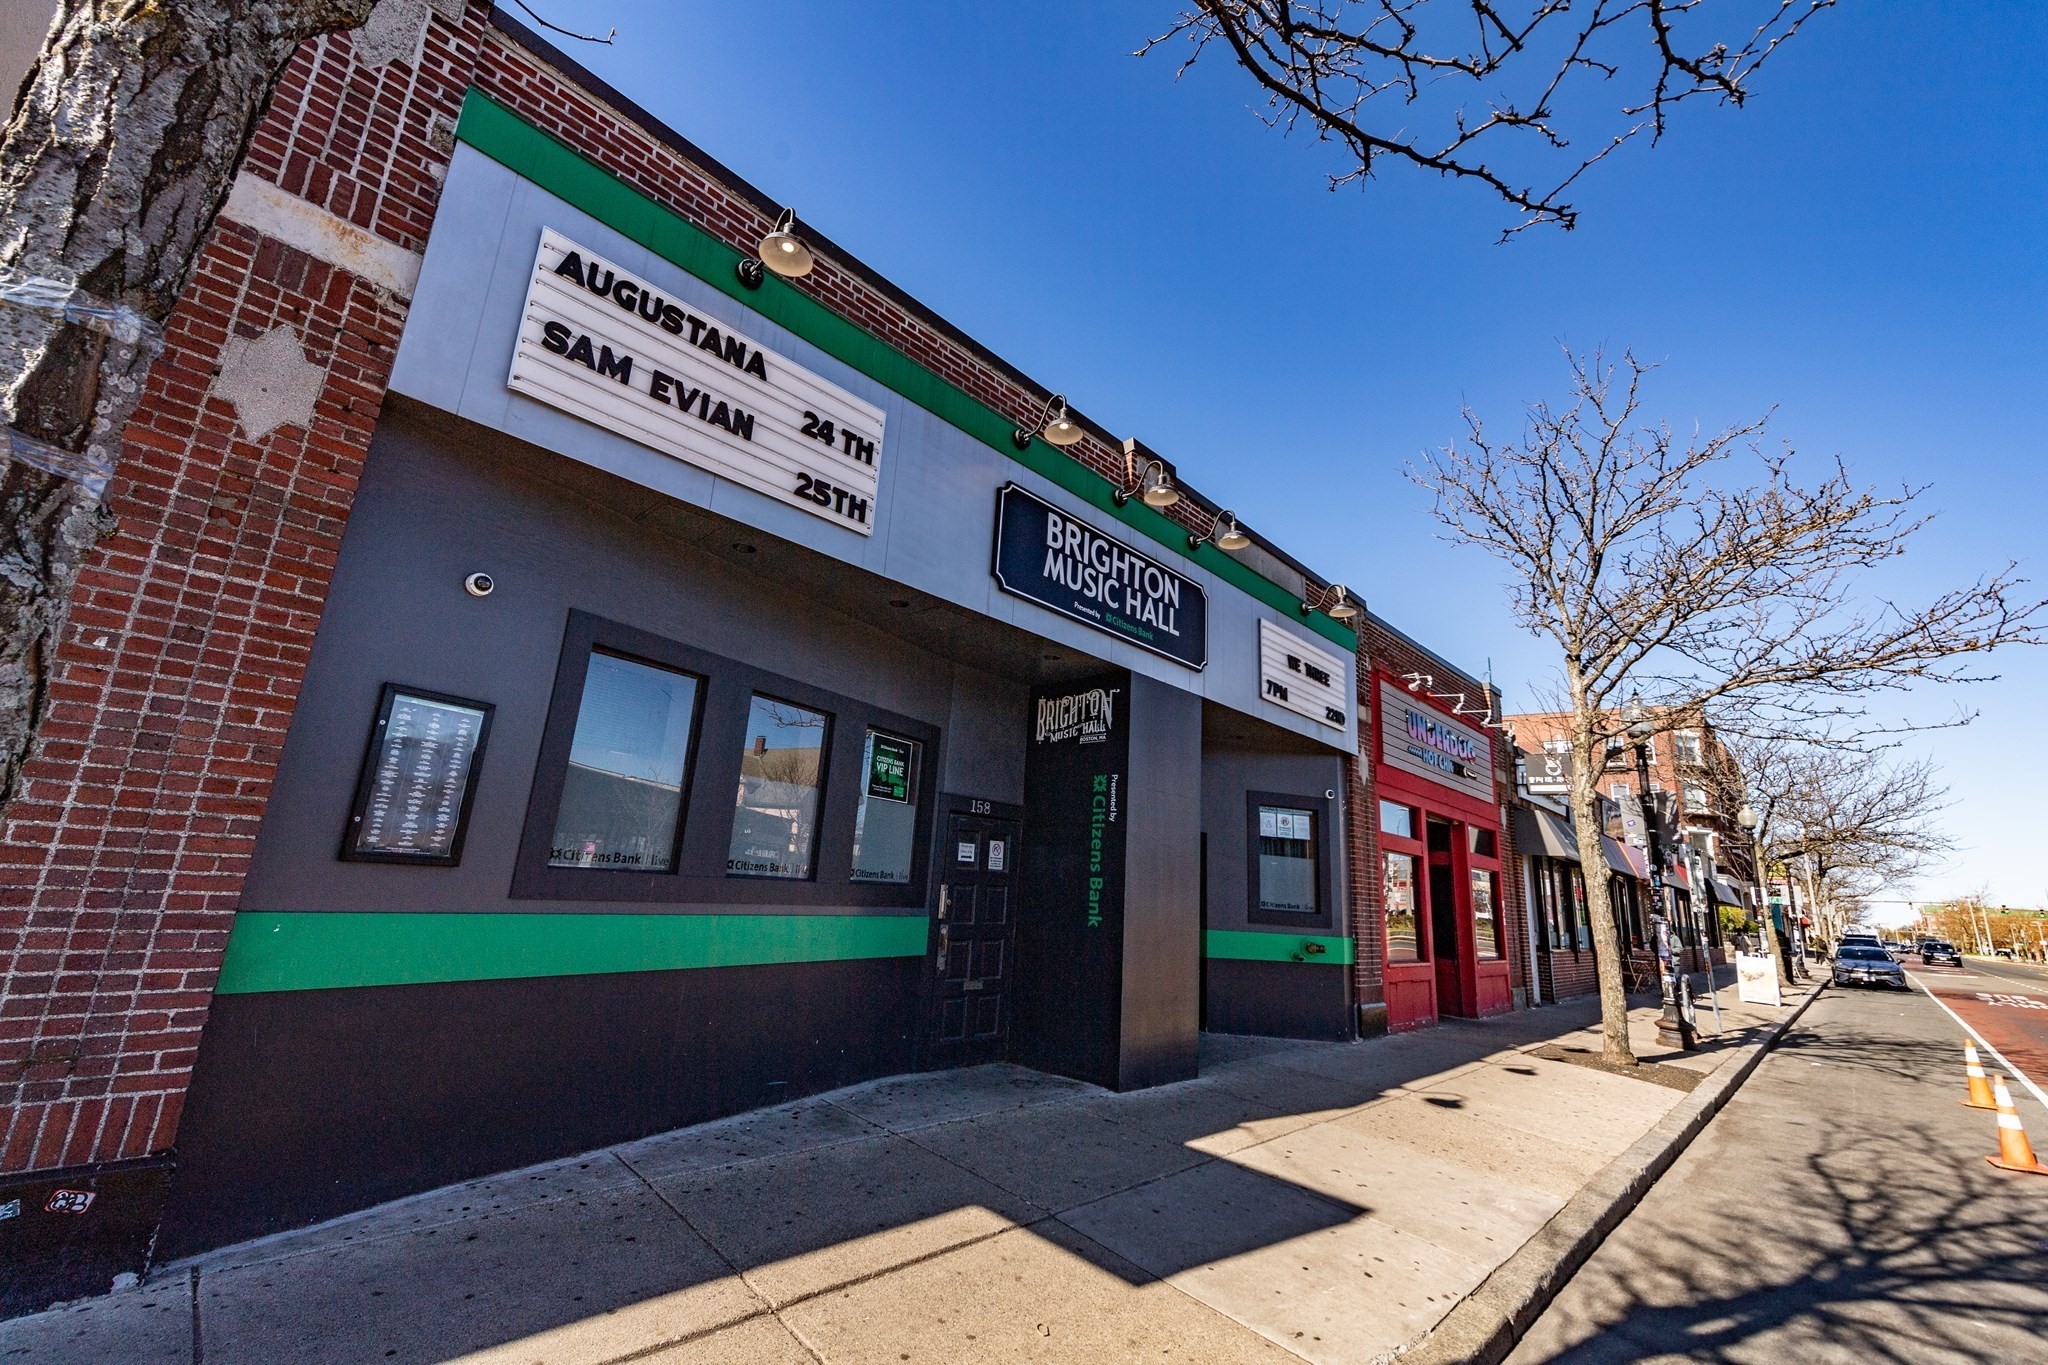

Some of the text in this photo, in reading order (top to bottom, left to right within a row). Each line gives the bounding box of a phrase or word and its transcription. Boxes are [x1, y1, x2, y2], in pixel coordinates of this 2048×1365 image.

[554, 251, 767, 381] AUGUSTANA
[541, 320, 755, 441] SAM EVIAN
[801, 411, 874, 465] 24 TH
[793, 472, 867, 523] 25TH
[1046, 512, 1179, 608] BRIGHTON
[1043, 549, 1179, 636] MUSIC HALL
[1074, 601, 1095, 616] Presented
[1112, 616, 1154, 640] Citizens Bank
[1266, 679, 1288, 702] 7PM
[1036, 688, 1120, 744] BRIGHTON
[1045, 720, 1106, 743] MUSIC HALL
[1406, 709, 1476, 762] UNDERDOG
[876, 755, 894, 765] CITIZENS
[876, 762, 904, 777] VIP LINE
[1422, 748, 1438, 767] HOT
[970, 799, 991, 815] 158
[1109, 774, 1118, 822] Presented by
[563, 849, 611, 863] Citizens
[613, 852, 641, 865] Bank
[735, 860, 768, 873] Citizens
[769, 862, 789, 873] Bank
[1087, 795, 1106, 927] Citizens Bank
[855, 868, 880, 879] Citizens
[880, 870, 894, 880] Bank
